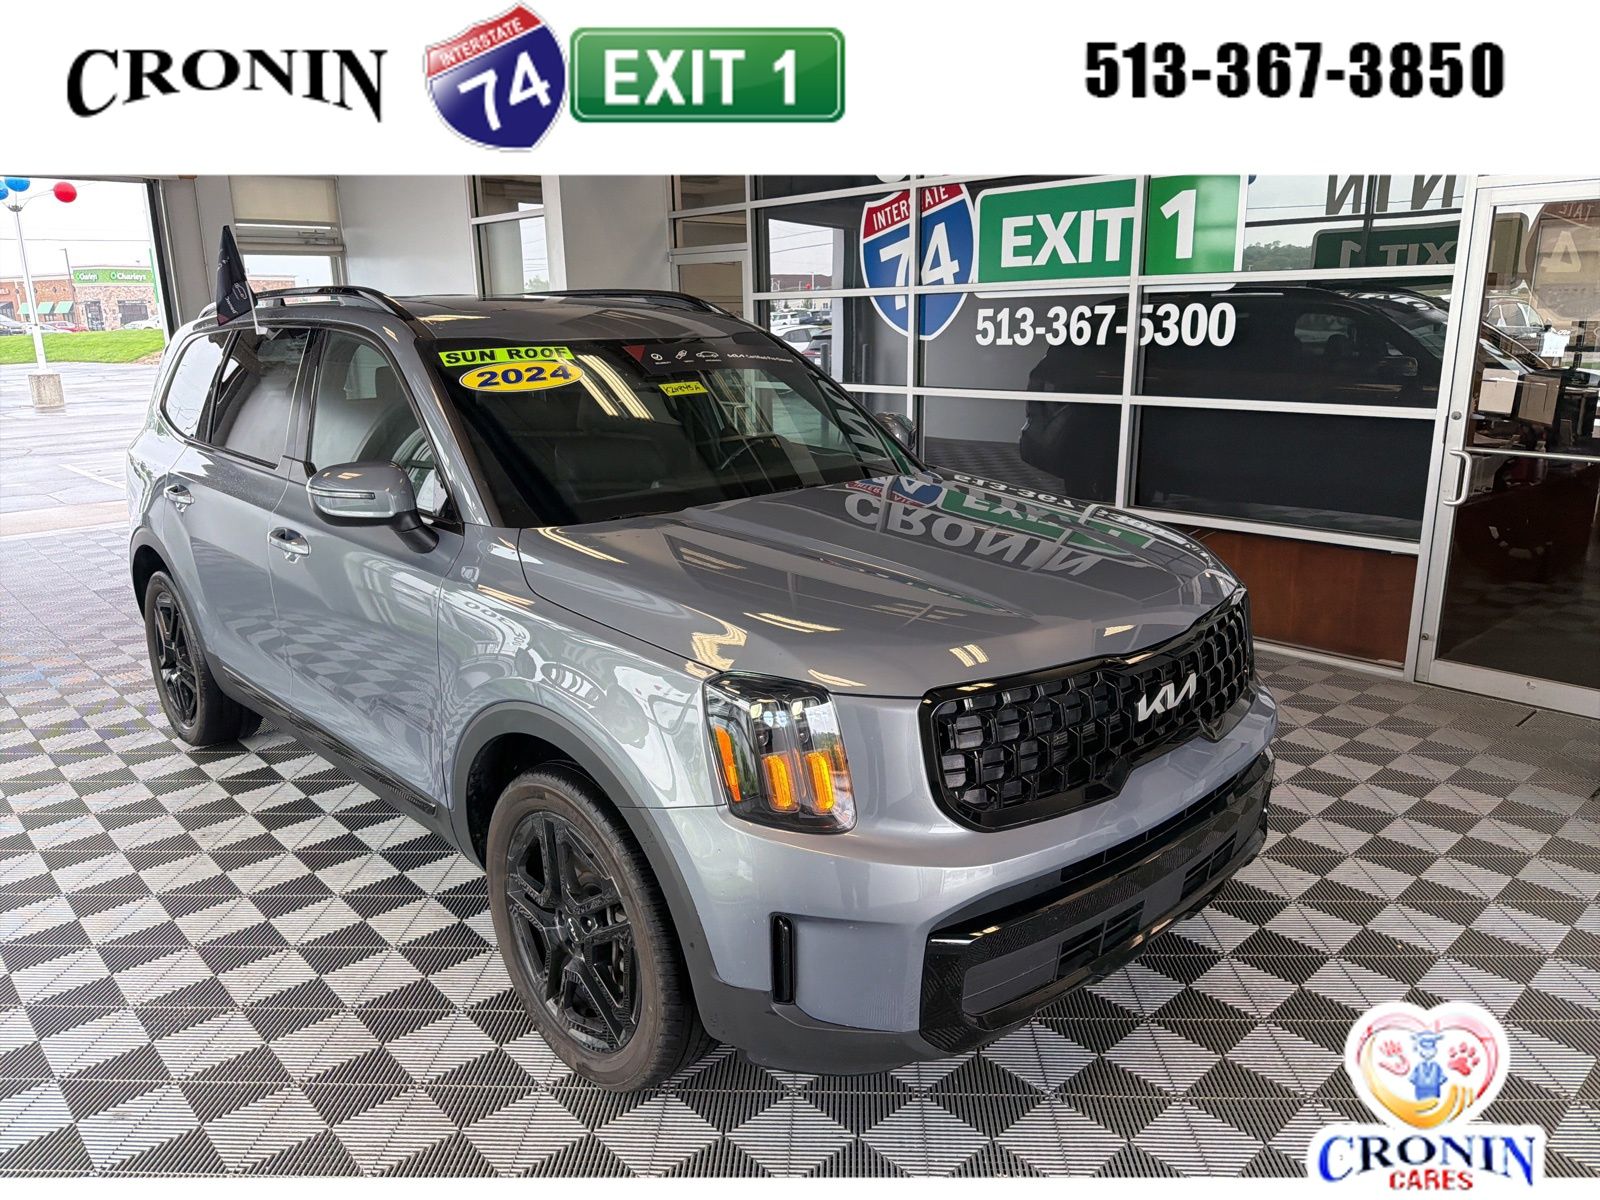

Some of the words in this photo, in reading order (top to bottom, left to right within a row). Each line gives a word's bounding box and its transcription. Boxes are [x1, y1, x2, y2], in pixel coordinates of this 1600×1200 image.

[872, 185, 949, 231] INTERATE
[1000, 206, 1137, 268] EXIT
[1159, 189, 1197, 259] 1
[879, 222, 960, 311] 74
[975, 302, 1237, 347] 513-367-5300
[445, 349, 497, 364] SUN
[506, 347, 568, 360] ROOF
[476, 365, 572, 388] 2024
